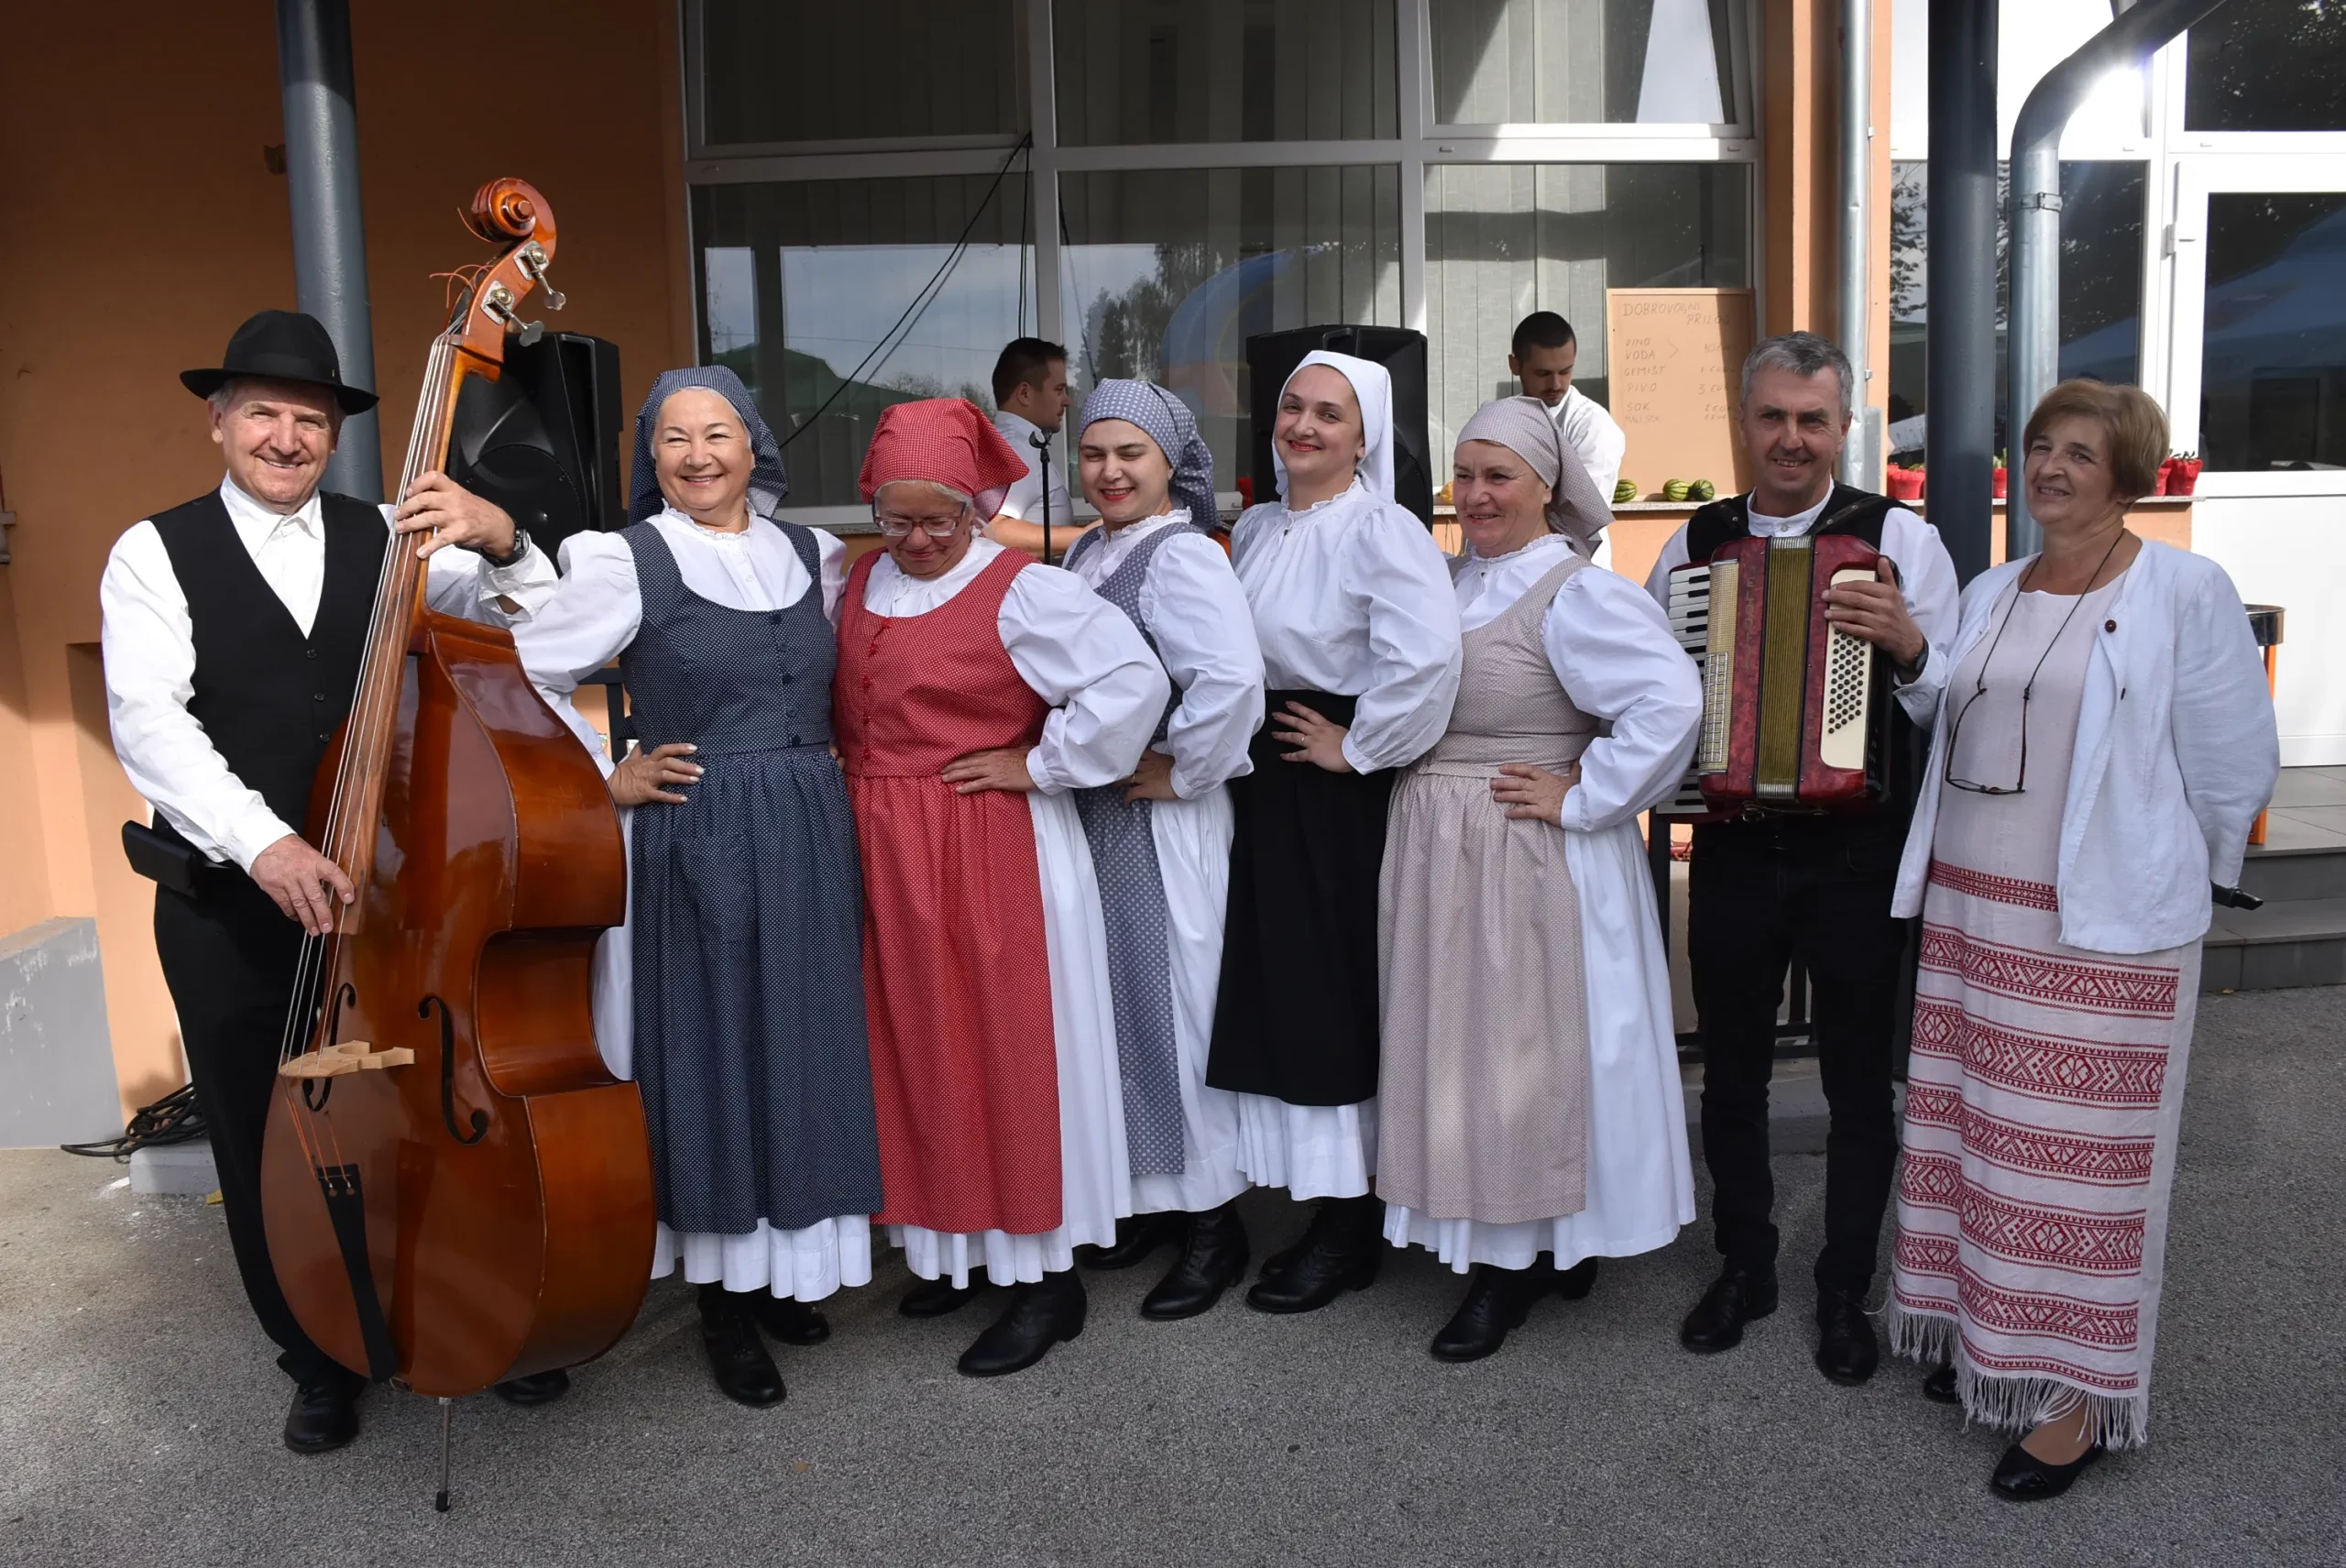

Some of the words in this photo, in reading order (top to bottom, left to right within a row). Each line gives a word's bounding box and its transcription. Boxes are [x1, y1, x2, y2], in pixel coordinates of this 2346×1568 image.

[1625, 337, 1650, 347] VINO
[1625, 349, 1656, 360] VODA
[1627, 382, 1657, 393] PIVO
[1627, 400, 1650, 412] SOK
